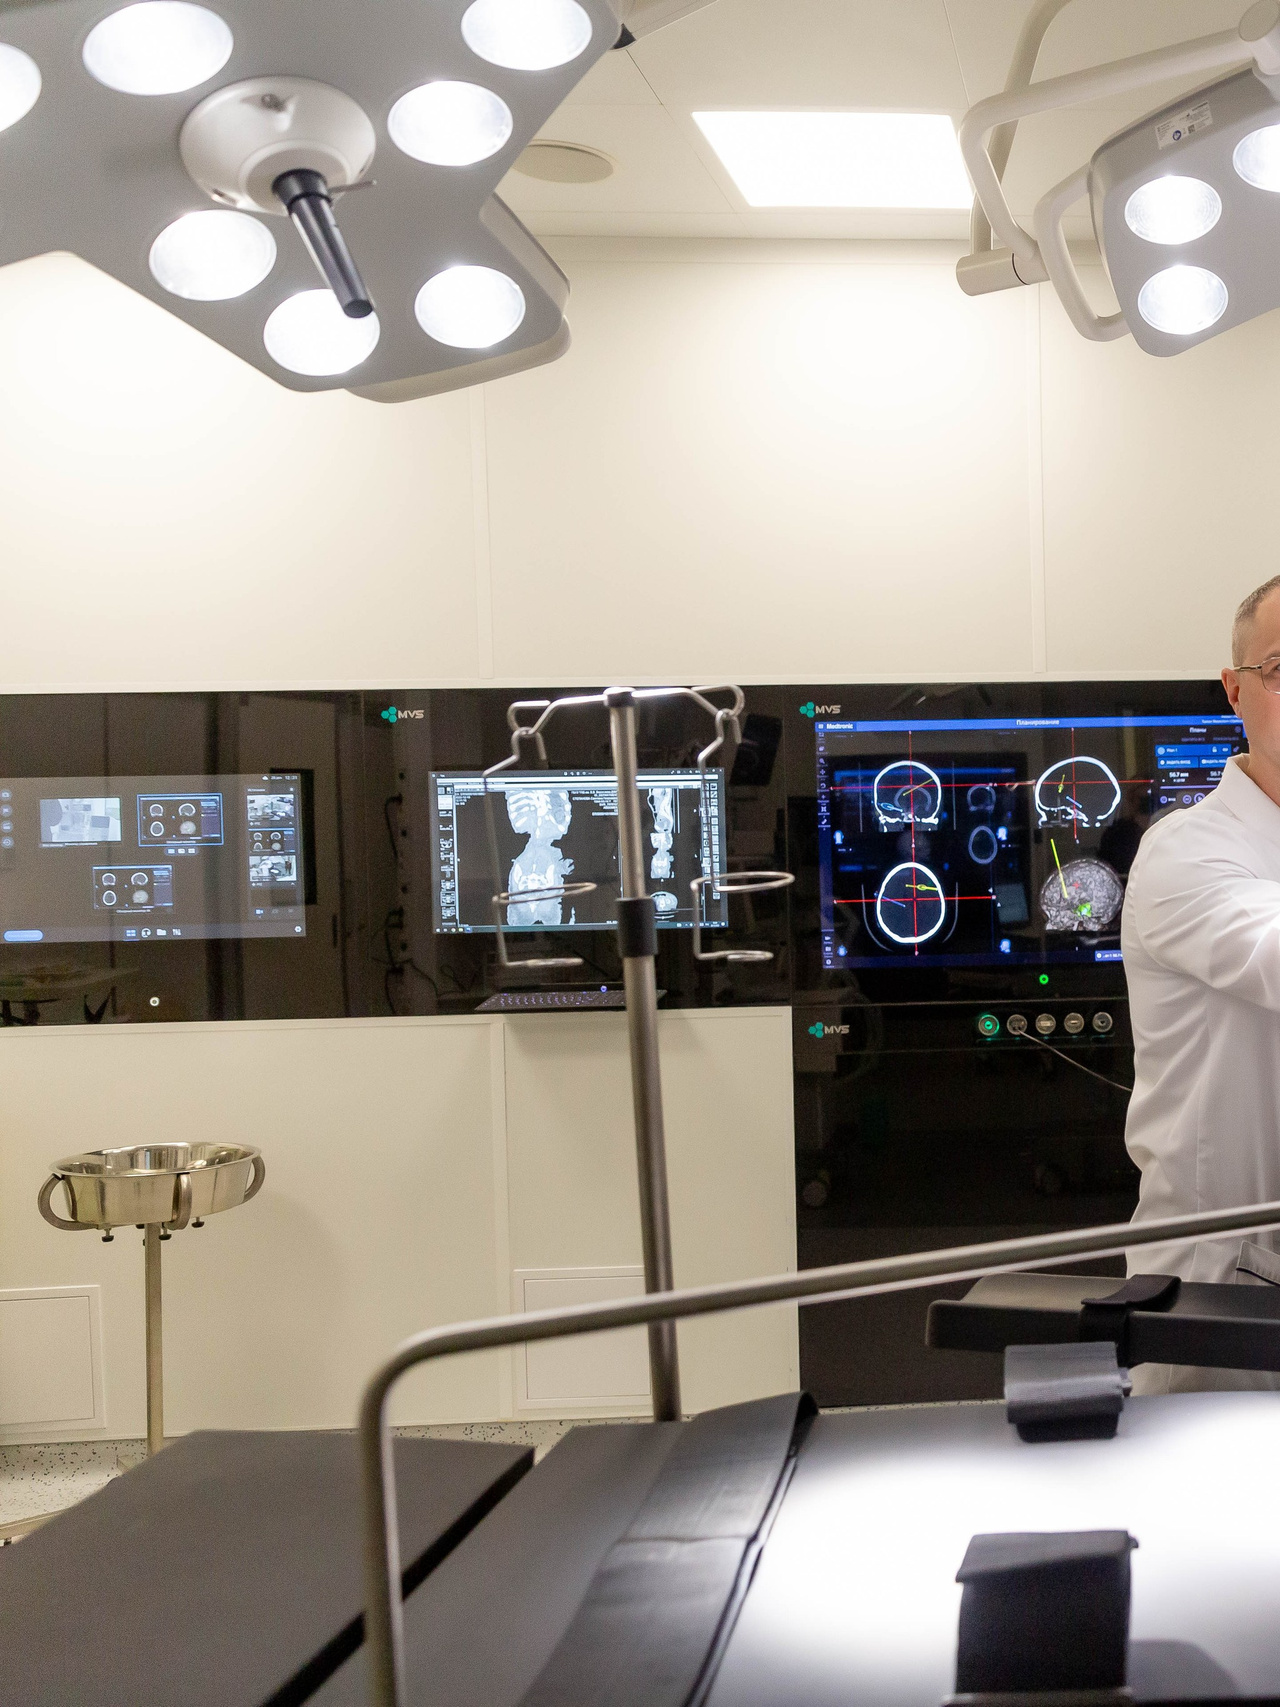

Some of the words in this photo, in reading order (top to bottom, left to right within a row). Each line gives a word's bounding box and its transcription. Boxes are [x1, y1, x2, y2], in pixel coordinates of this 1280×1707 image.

[815, 705, 841, 714] MVS
[397, 710, 425, 719] MVS
[824, 1024, 850, 1035] MVS
